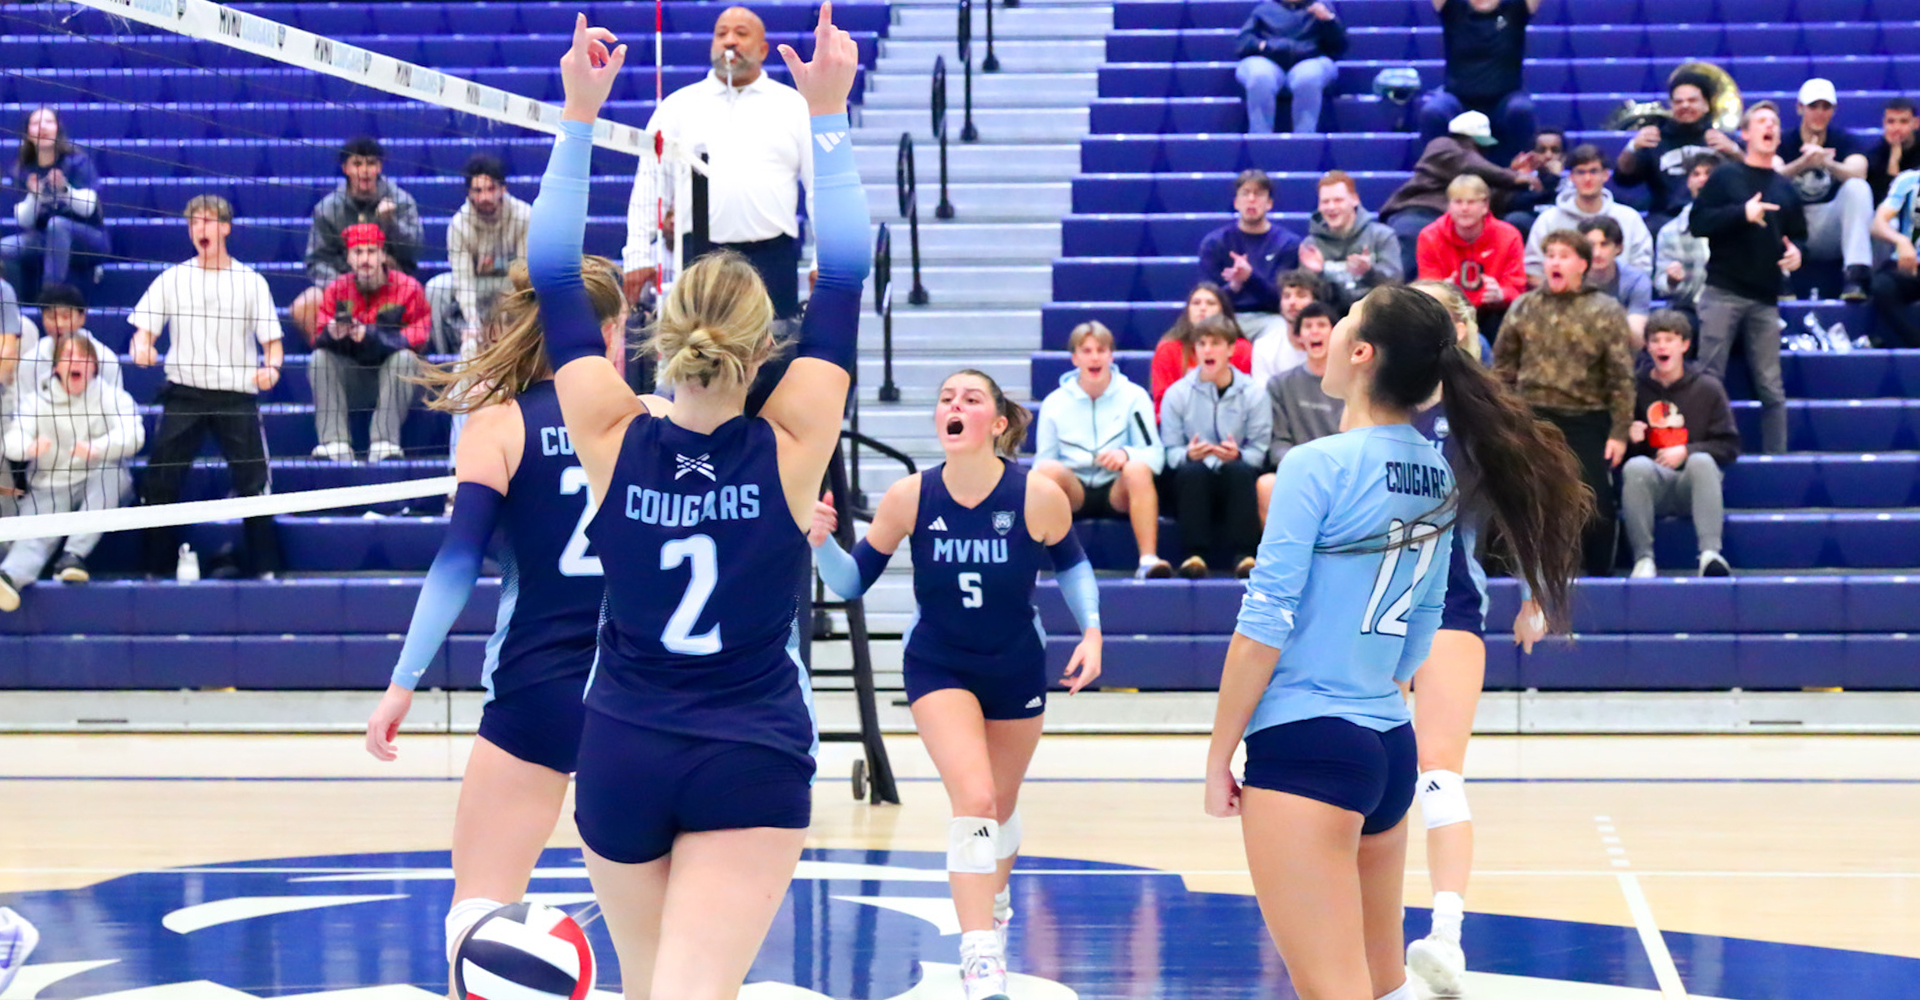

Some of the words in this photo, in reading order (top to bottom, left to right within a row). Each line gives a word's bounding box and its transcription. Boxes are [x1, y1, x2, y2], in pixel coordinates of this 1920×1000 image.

[625, 484, 760, 527] COUGARS
[933, 538, 1008, 563] MVNU
[660, 533, 723, 655] 2
[958, 572, 983, 608] 5
[1361, 518, 1440, 637] 12
